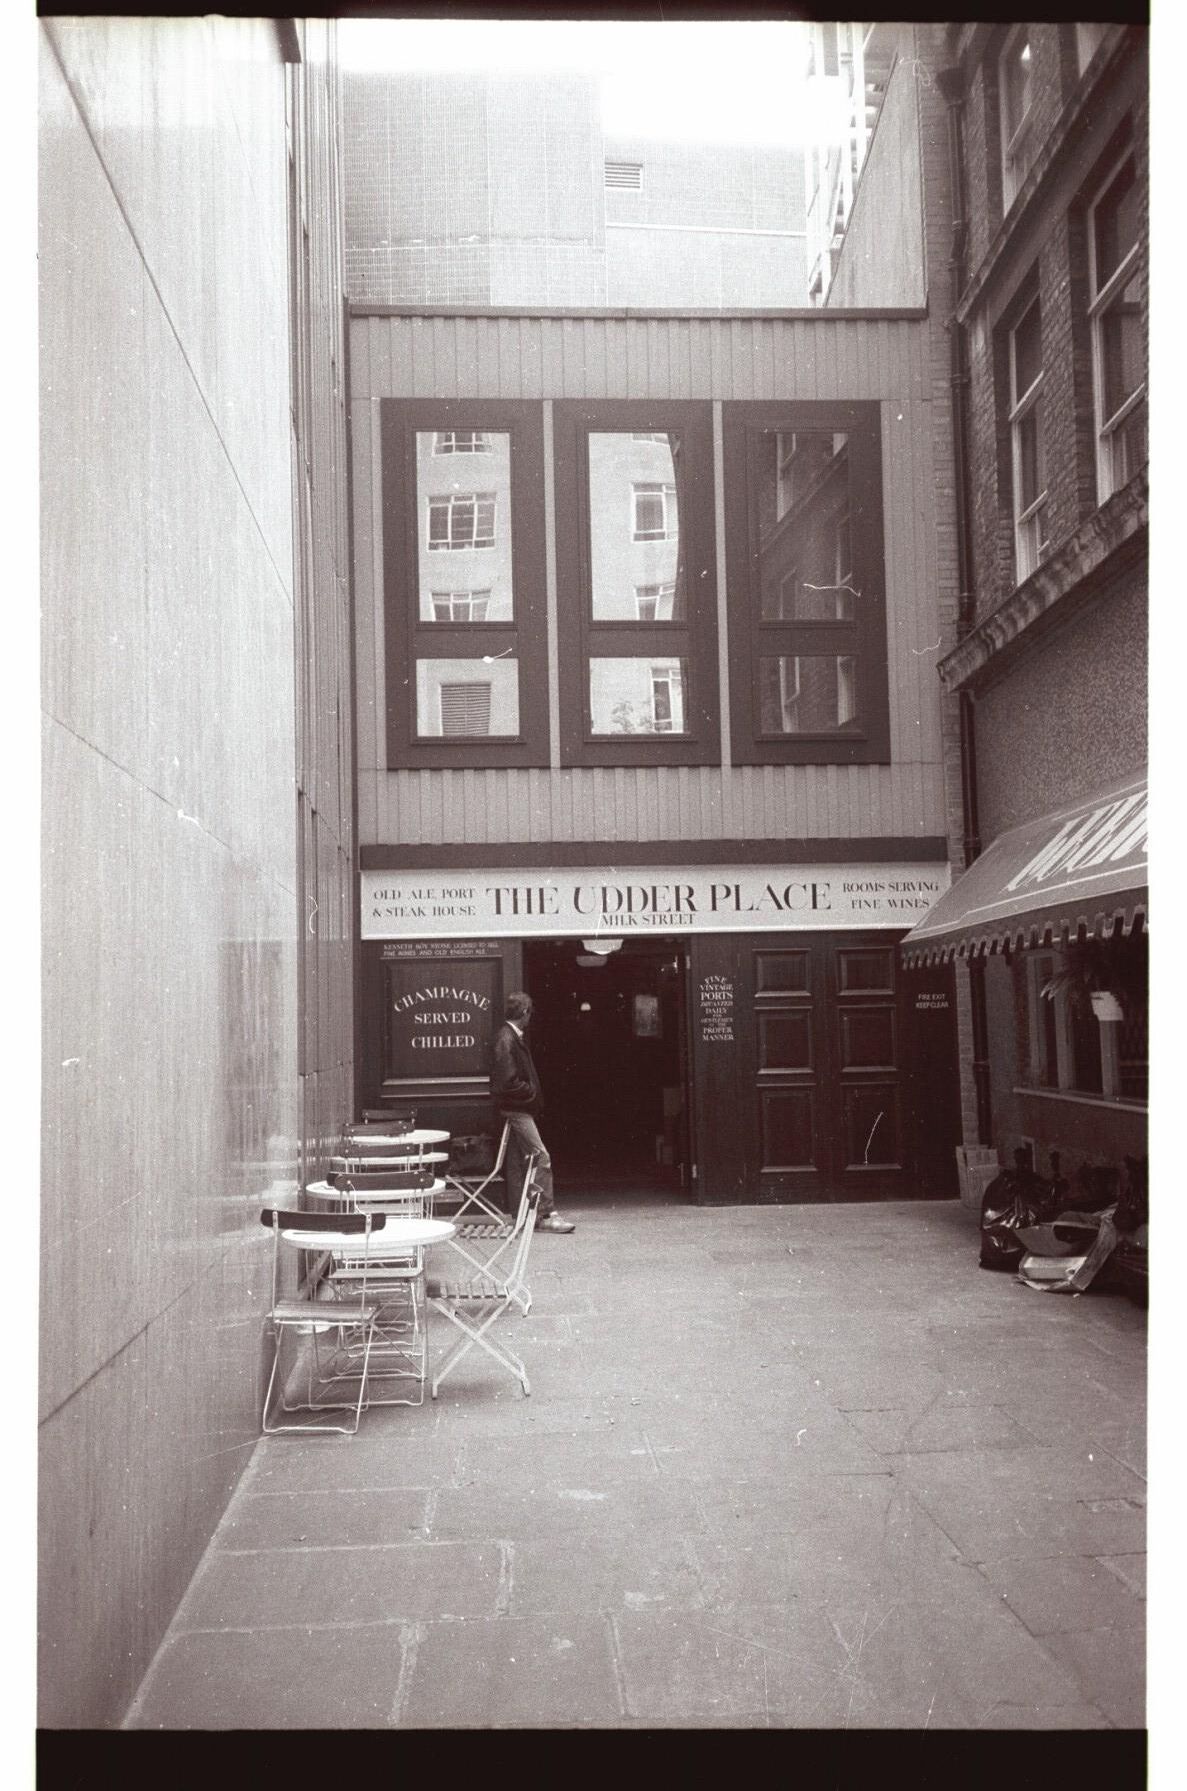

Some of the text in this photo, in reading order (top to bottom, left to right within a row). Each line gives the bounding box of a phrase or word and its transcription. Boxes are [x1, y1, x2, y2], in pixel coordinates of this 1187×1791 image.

[373, 887, 476, 900] OLD ALE PORT
[843, 882, 939, 893] ROOMS SERVING
[486, 883, 832, 915] THE UDDER PLACE
[851, 898, 930, 910] FINE WINES
[372, 905, 477, 917] & STEAK HOUSE
[602, 913, 696, 926] MILK STREET
[434, 948, 448, 956] OLD
[704, 975, 728, 984] FINE
[700, 984, 734, 992] VINTAGE
[394, 986, 491, 1012] CHAMPAGNE
[700, 991, 734, 1001] PORTS
[414, 1012, 471, 1024] SERVED
[411, 1035, 475, 1049] CHILLED
